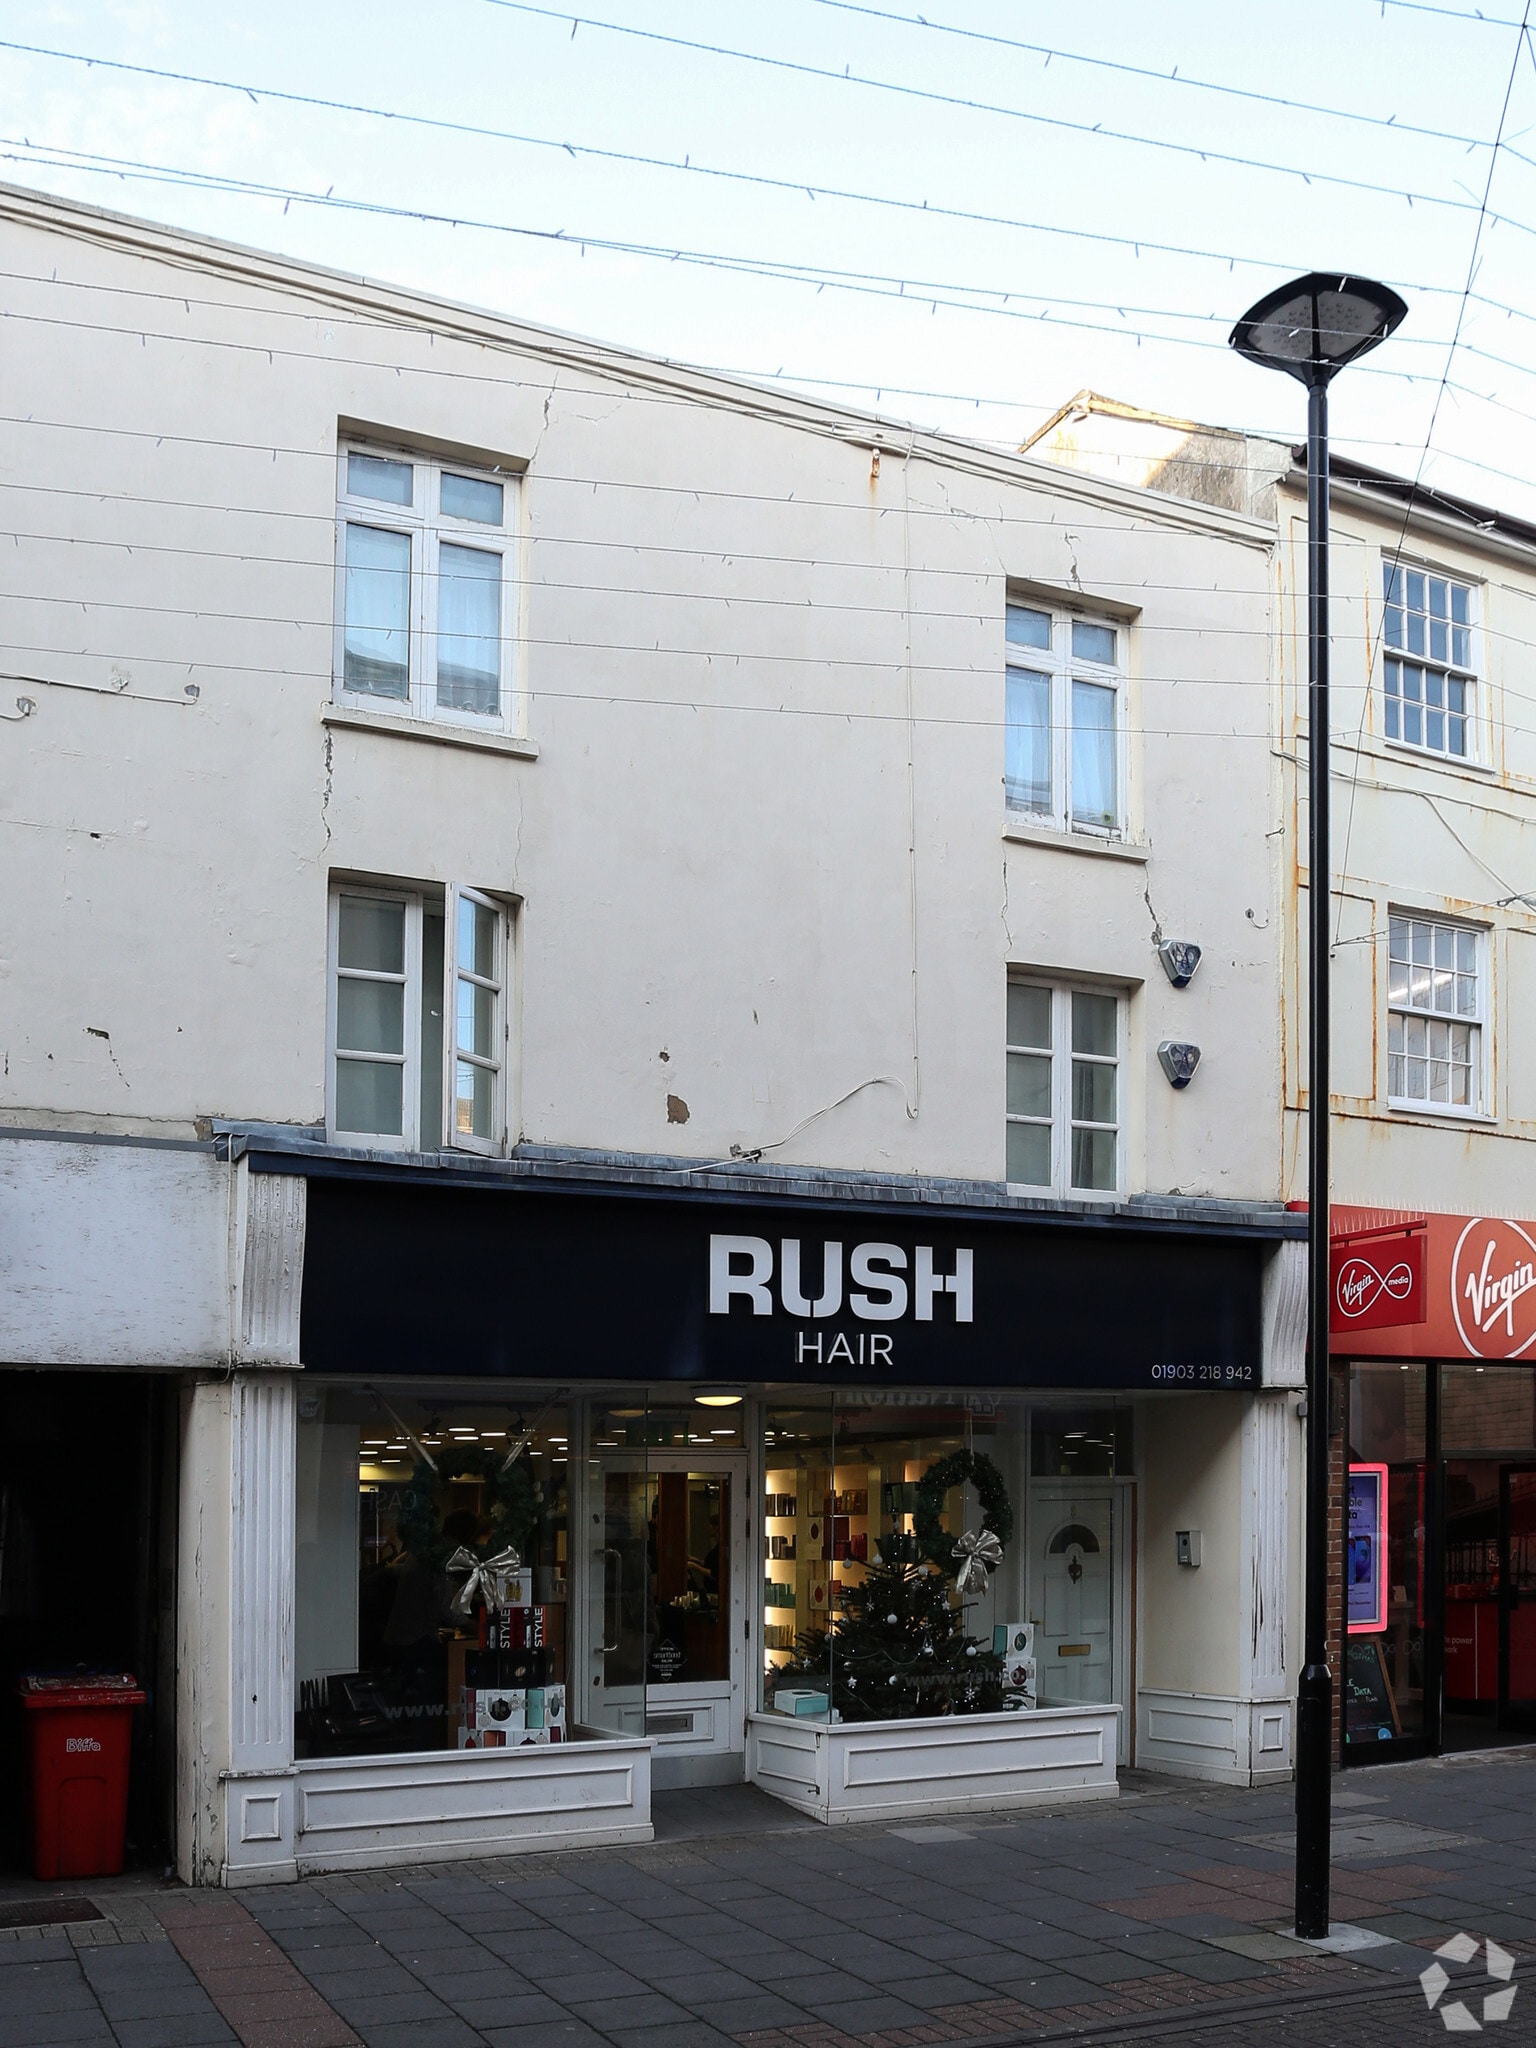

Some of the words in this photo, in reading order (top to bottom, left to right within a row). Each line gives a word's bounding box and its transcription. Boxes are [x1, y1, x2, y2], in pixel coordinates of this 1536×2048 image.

[710, 1234, 973, 1322] RUSH
[1342, 1269, 1374, 1306] Virgin
[1388, 1276, 1409, 1285] media
[1464, 1240, 1536, 1337] Virgin
[799, 1332, 893, 1365] HAIR
[1152, 1365, 1194, 1378] 01903
[1200, 1366, 1220, 1378] 218
[1226, 1366, 1251, 1379] 942
[500, 1607, 510, 1648] STYLE
[534, 1607, 543, 1648] STYLE
[66, 1737, 101, 1752] Biffa
